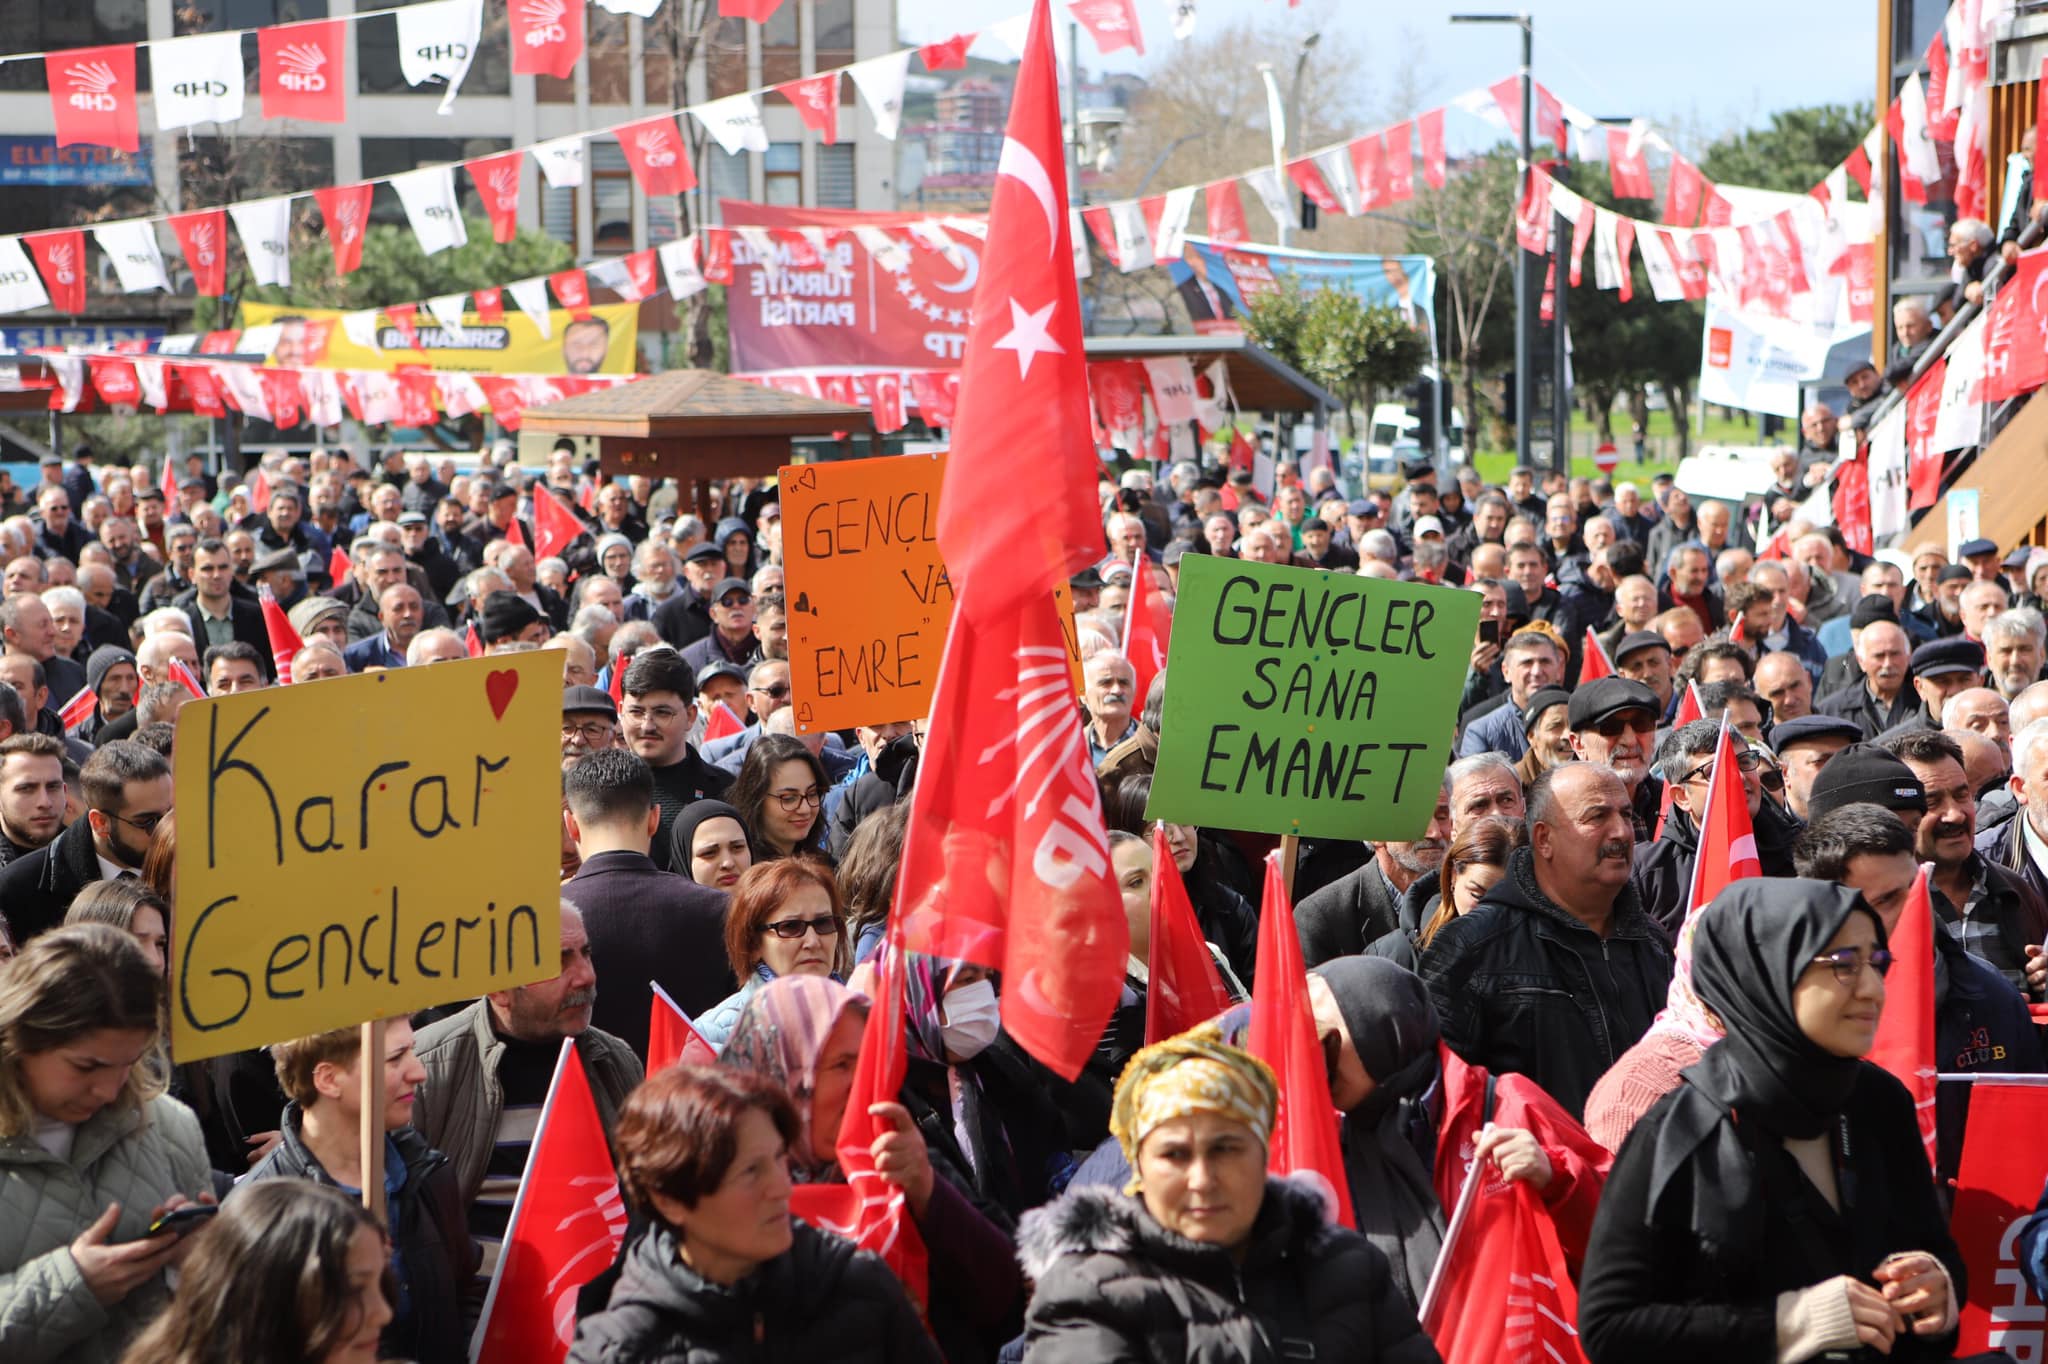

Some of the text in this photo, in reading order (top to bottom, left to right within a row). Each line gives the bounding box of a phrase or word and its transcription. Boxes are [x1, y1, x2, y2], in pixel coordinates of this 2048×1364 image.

[11, 144, 137, 165] ELEKTR
[902, 564, 954, 604] VA
[1212, 575, 1436, 661] GENÇLER
[1241, 657, 1378, 721] SANA
[208, 703, 511, 869] Karar
[1200, 724, 1428, 804] EMANET
